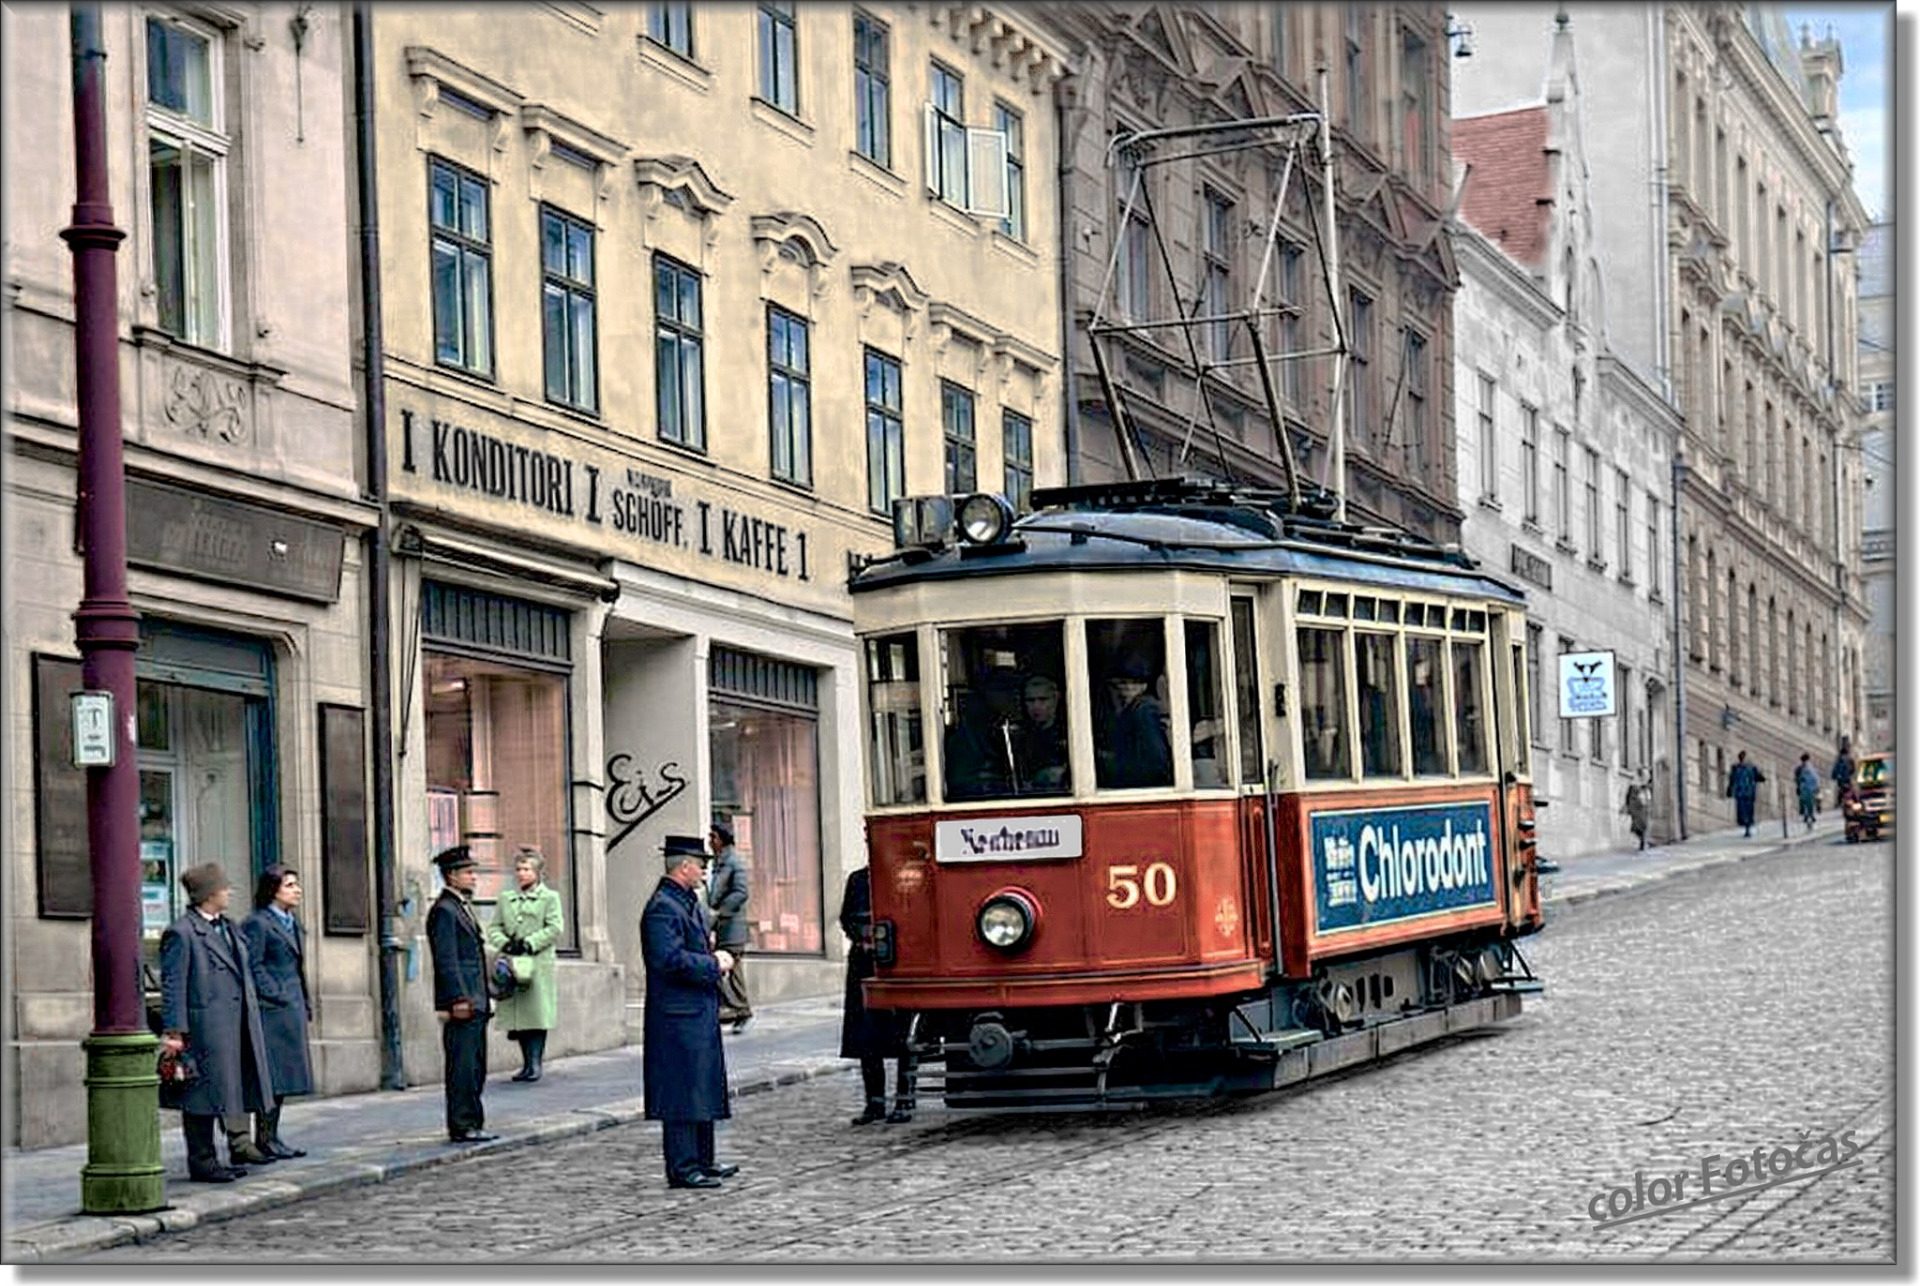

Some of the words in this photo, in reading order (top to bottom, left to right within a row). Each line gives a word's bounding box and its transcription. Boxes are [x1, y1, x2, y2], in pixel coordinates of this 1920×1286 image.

[431, 419, 574, 517] KONDITORI
[722, 509, 788, 576] KAFFE
[606, 753, 686, 853] Eis
[1106, 862, 1176, 909] 50
[1358, 818, 1488, 903] Chlorodont
